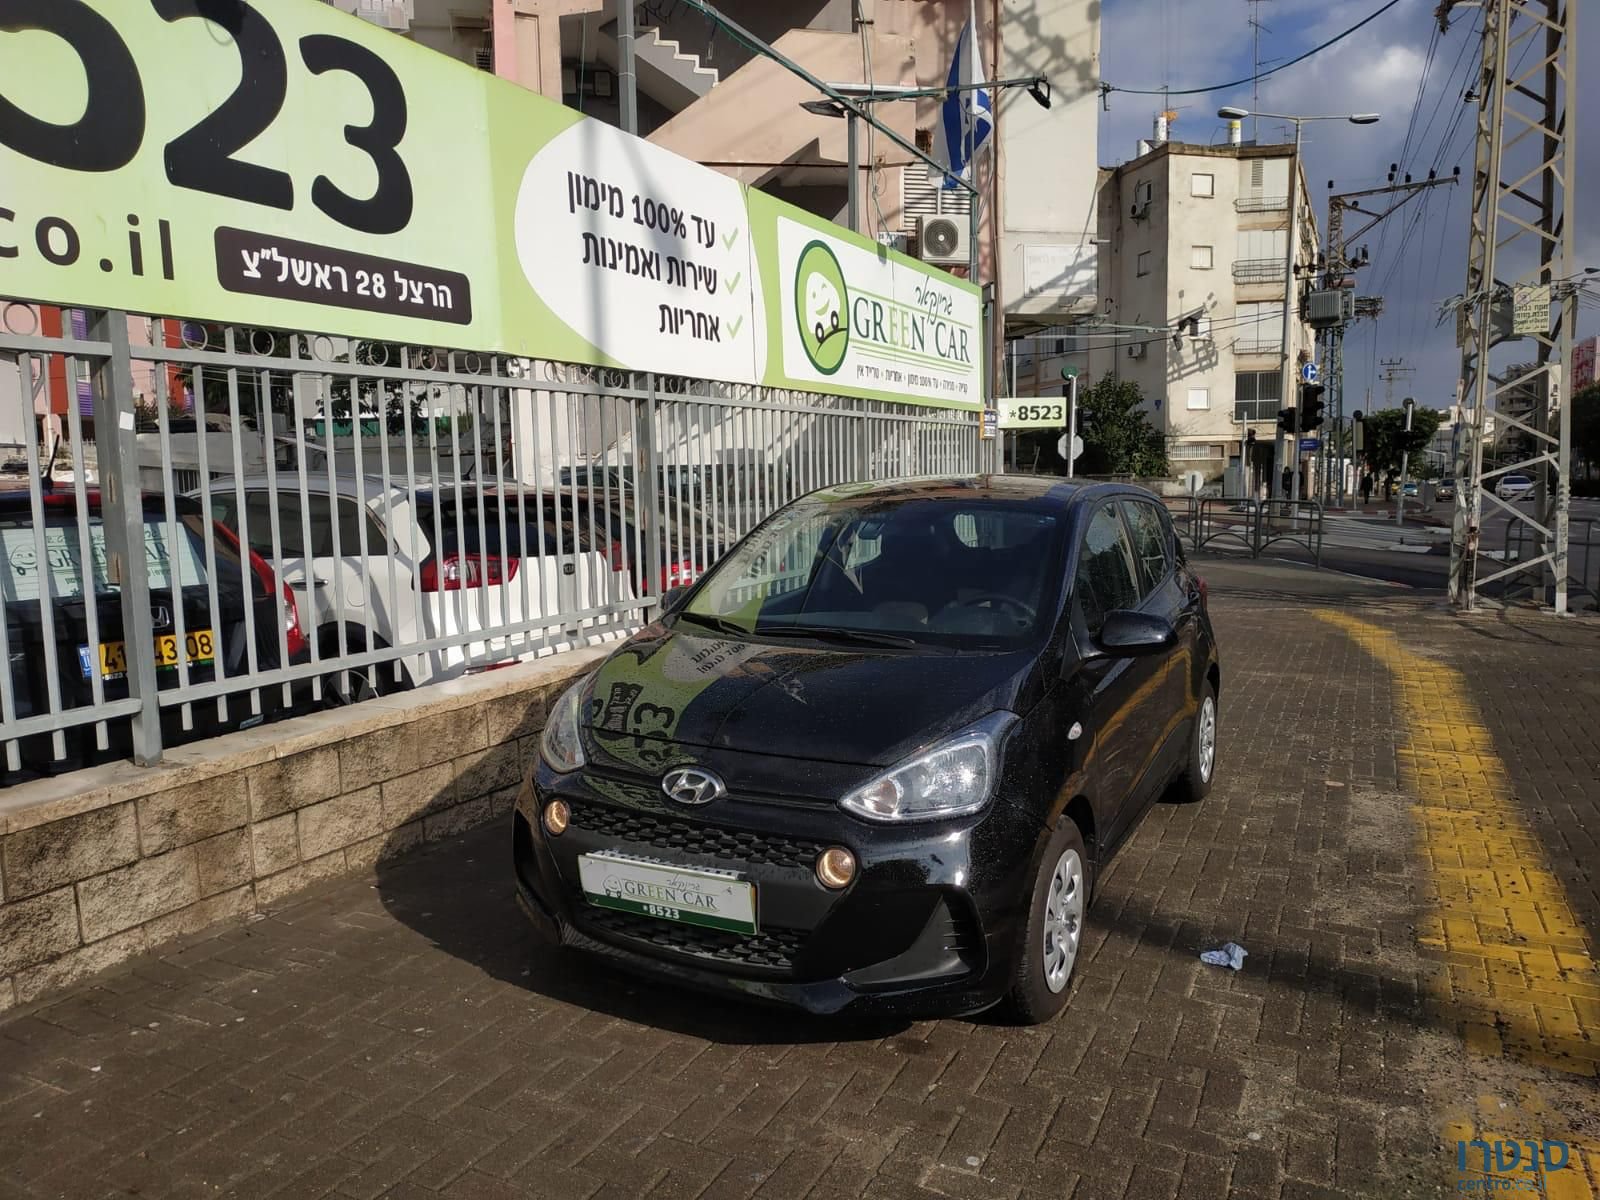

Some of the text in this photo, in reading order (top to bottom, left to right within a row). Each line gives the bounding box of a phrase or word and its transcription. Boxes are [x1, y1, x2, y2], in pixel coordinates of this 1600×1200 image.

[567, 171, 716, 249] עד 100% מימון
[582, 231, 718, 295] שירות ואמינות
[354, 270, 387, 299] 28
[393, 270, 453, 309] הרצל
[658, 303, 721, 343] אחריות
[853, 296, 971, 363] GREEN CAR
[624, 881, 718, 910] GREEN CAR
